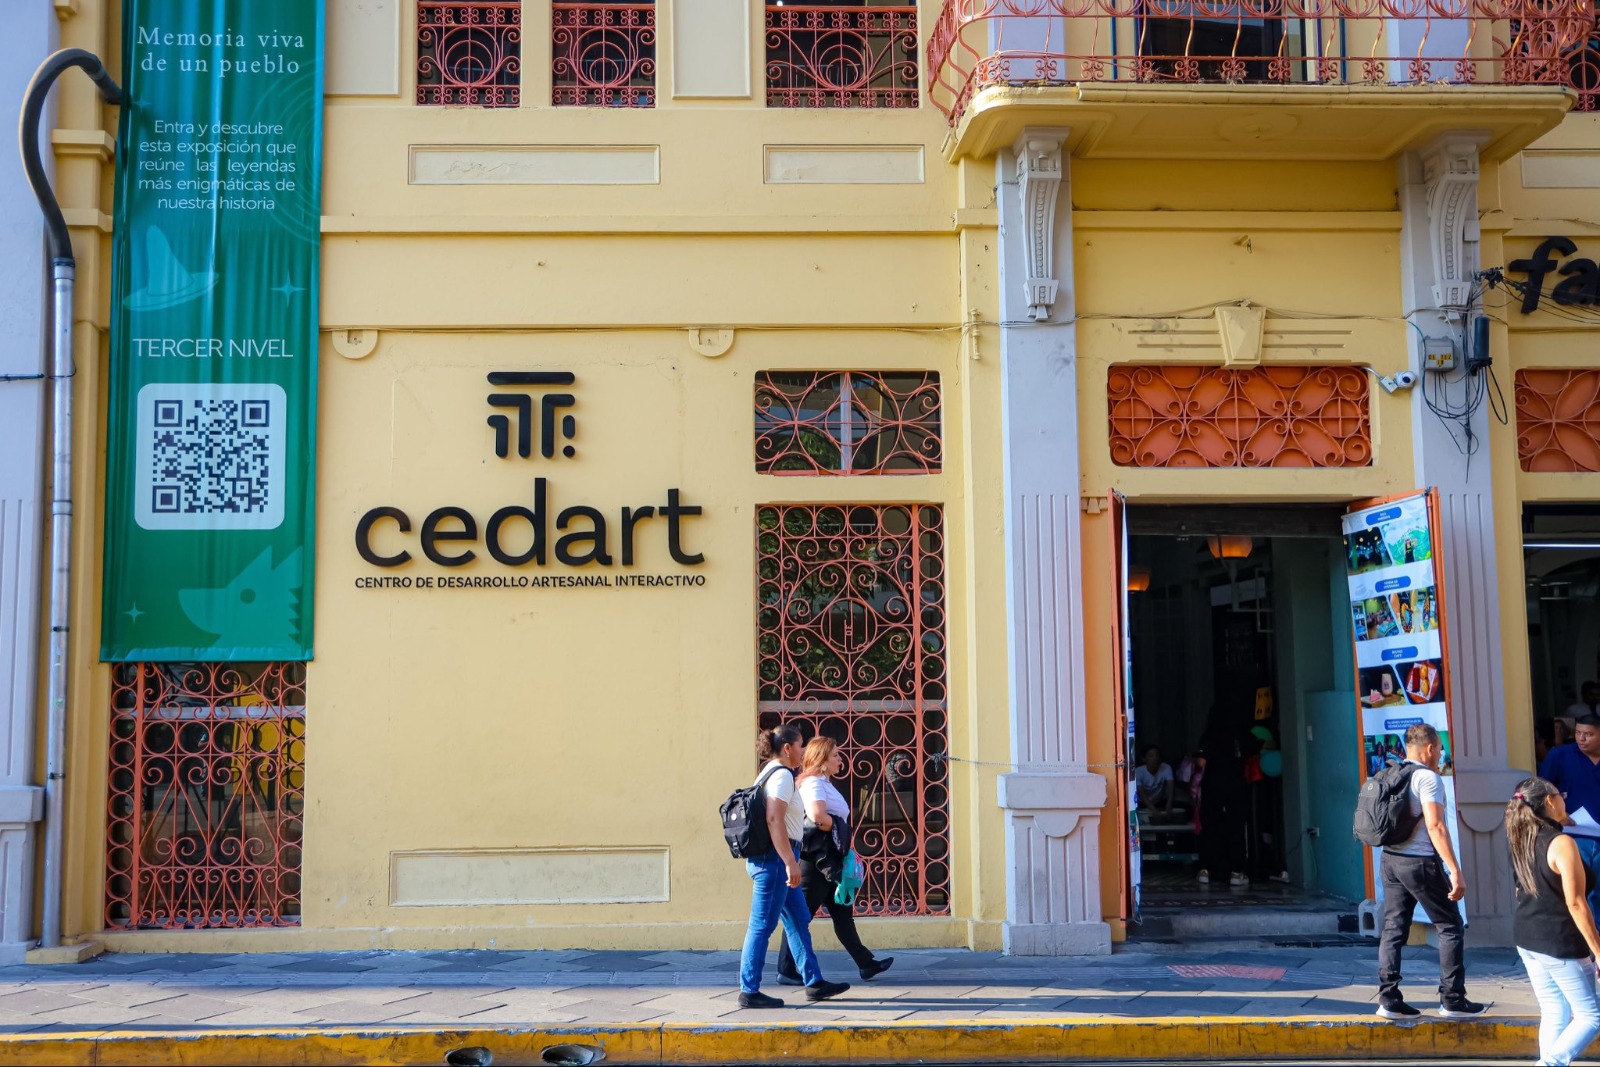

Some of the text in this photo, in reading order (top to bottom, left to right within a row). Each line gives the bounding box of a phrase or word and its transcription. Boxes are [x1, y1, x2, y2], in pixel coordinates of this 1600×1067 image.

[136, 26, 305, 48] Memoria viva
[141, 52, 300, 77] de un pueblo
[155, 120, 283, 136] Entra y descubre
[139, 140, 296, 157] esta exposición que
[139, 158, 296, 175] reúne las leyendas
[138, 177, 295, 193] más enigmáticas de
[158, 196, 275, 209] nuestra historia
[1509, 236, 1600, 314] fa
[133, 338, 293, 358] TERCER NIVEL
[355, 477, 706, 567] cedart
[354, 574, 706, 589] CENTRO DE DESARROLLO ARTESANAL INTERACTIVO
